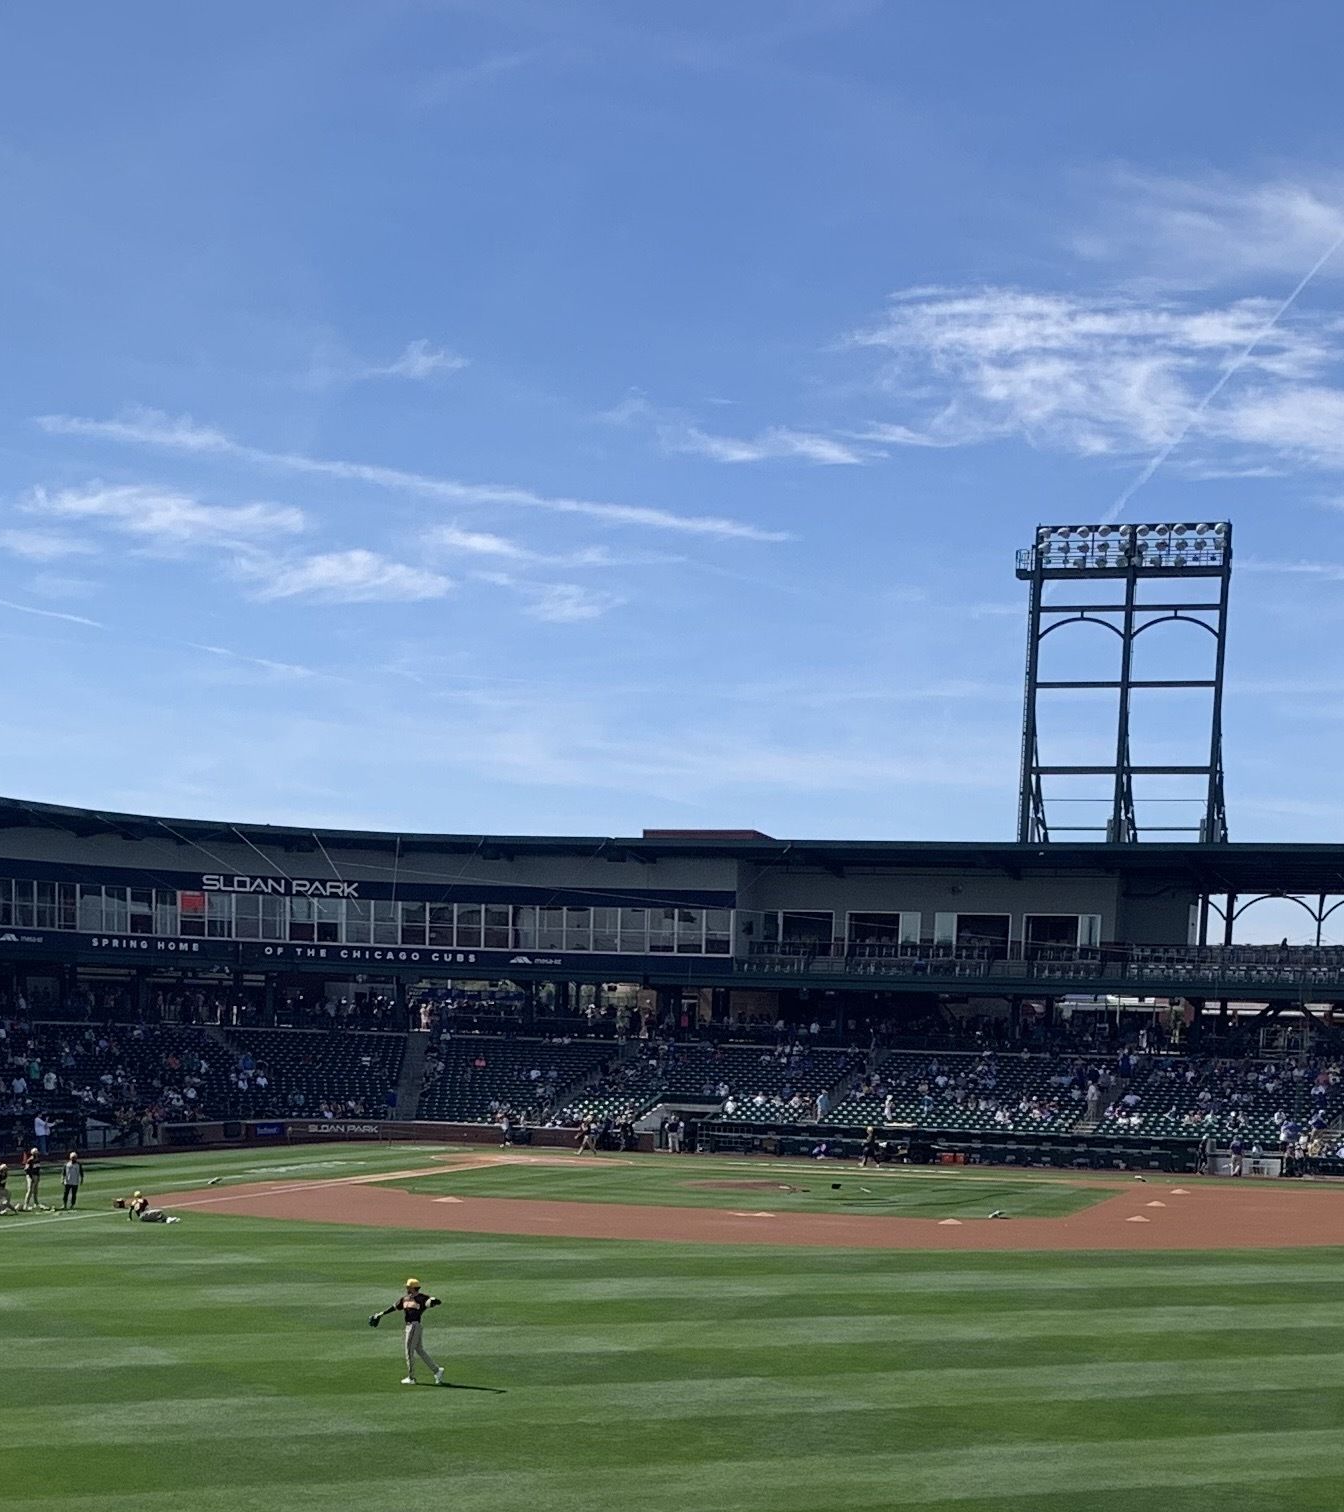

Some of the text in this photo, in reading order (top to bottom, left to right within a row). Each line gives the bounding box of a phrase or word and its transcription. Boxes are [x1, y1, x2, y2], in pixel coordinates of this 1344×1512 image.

[202, 875, 359, 897] SLOAN PARK
[92, 938, 477, 963] SPRING HOME OF THE CHICAGO CUBS
[308, 1124, 379, 1133] SLOAN PARK
